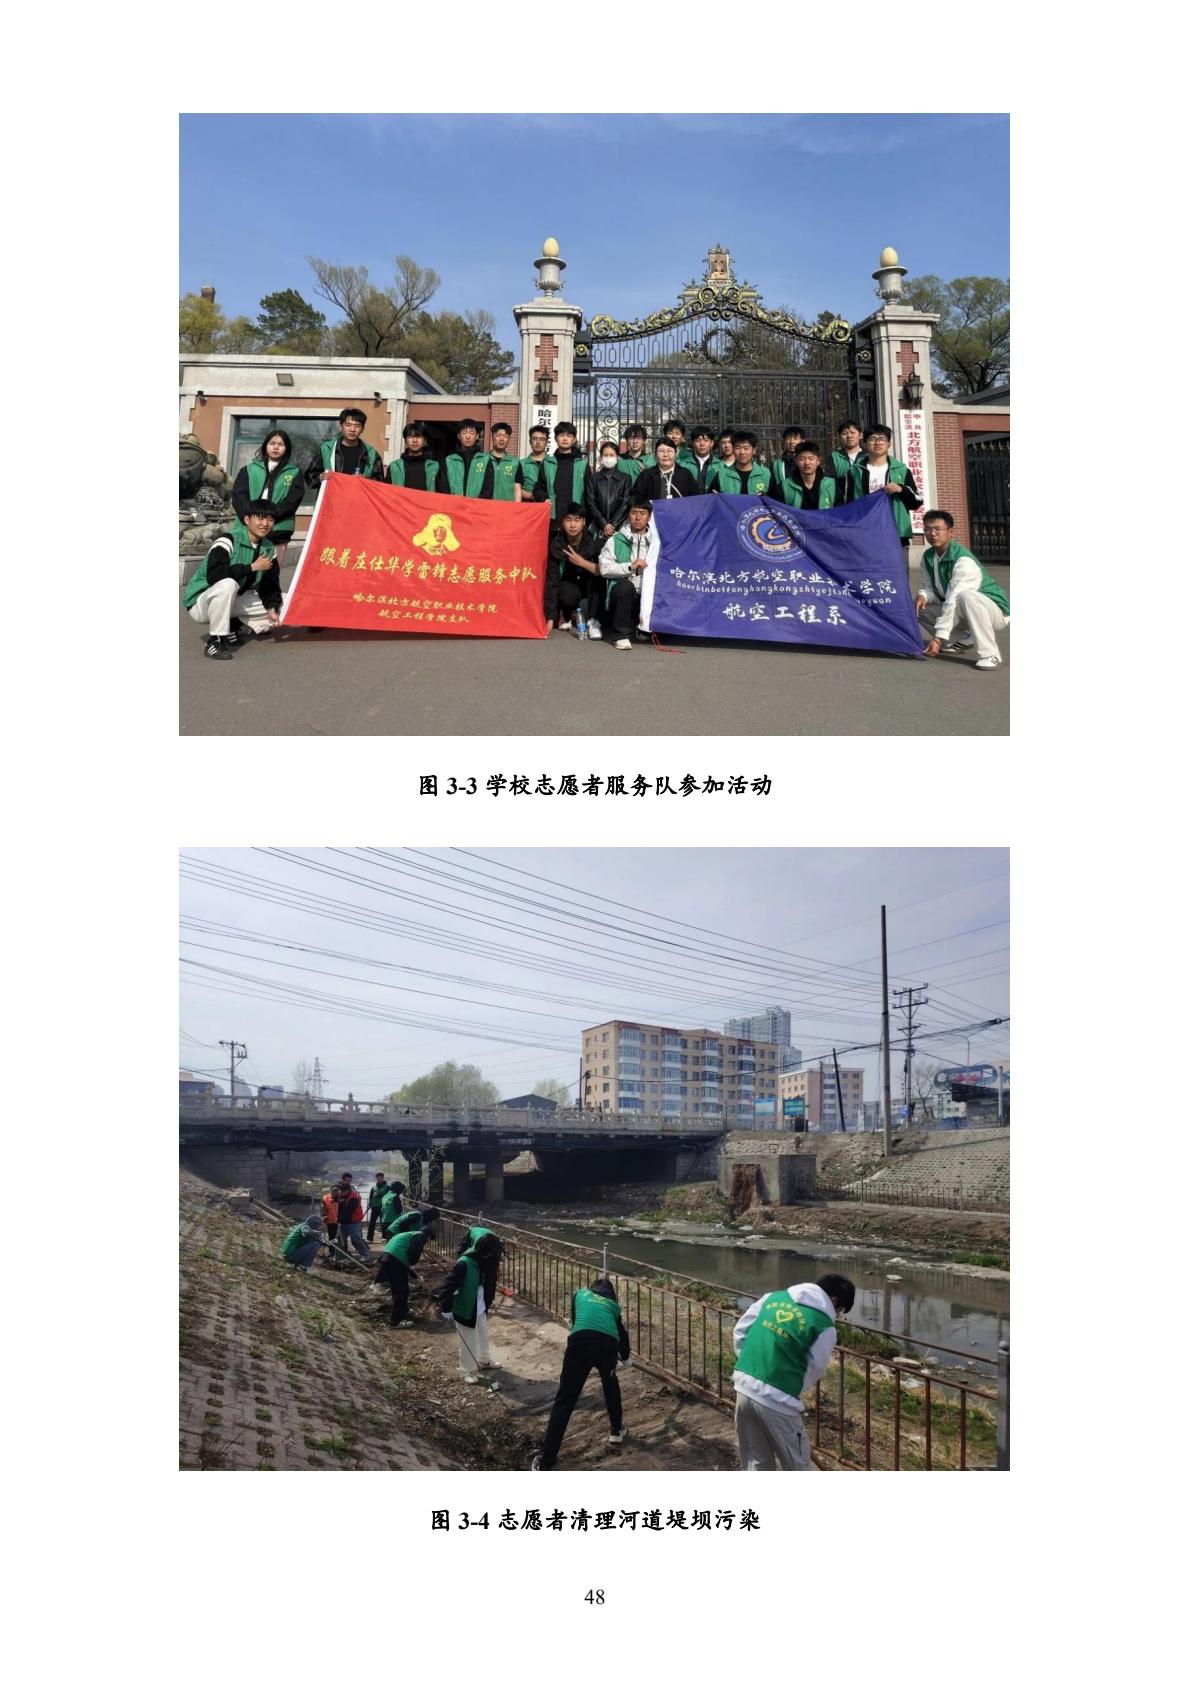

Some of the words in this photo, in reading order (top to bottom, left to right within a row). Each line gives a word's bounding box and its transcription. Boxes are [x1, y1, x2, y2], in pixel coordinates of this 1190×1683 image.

[319, 546, 537, 585] 跟着庄仕华学雷锋志愿服务中队
[722, 602, 847, 626] 航空工程系
[419, 774, 438, 796] 图
[446, 777, 478, 794] 3-3
[486, 773, 772, 797] 学校志愿者服务队参加活动
[431, 1509, 450, 1531] 图
[458, 1511, 490, 1530] 3-4
[498, 1508, 761, 1531] 志愿者清理河道堤坝污染
[584, 1589, 605, 1605] 48
